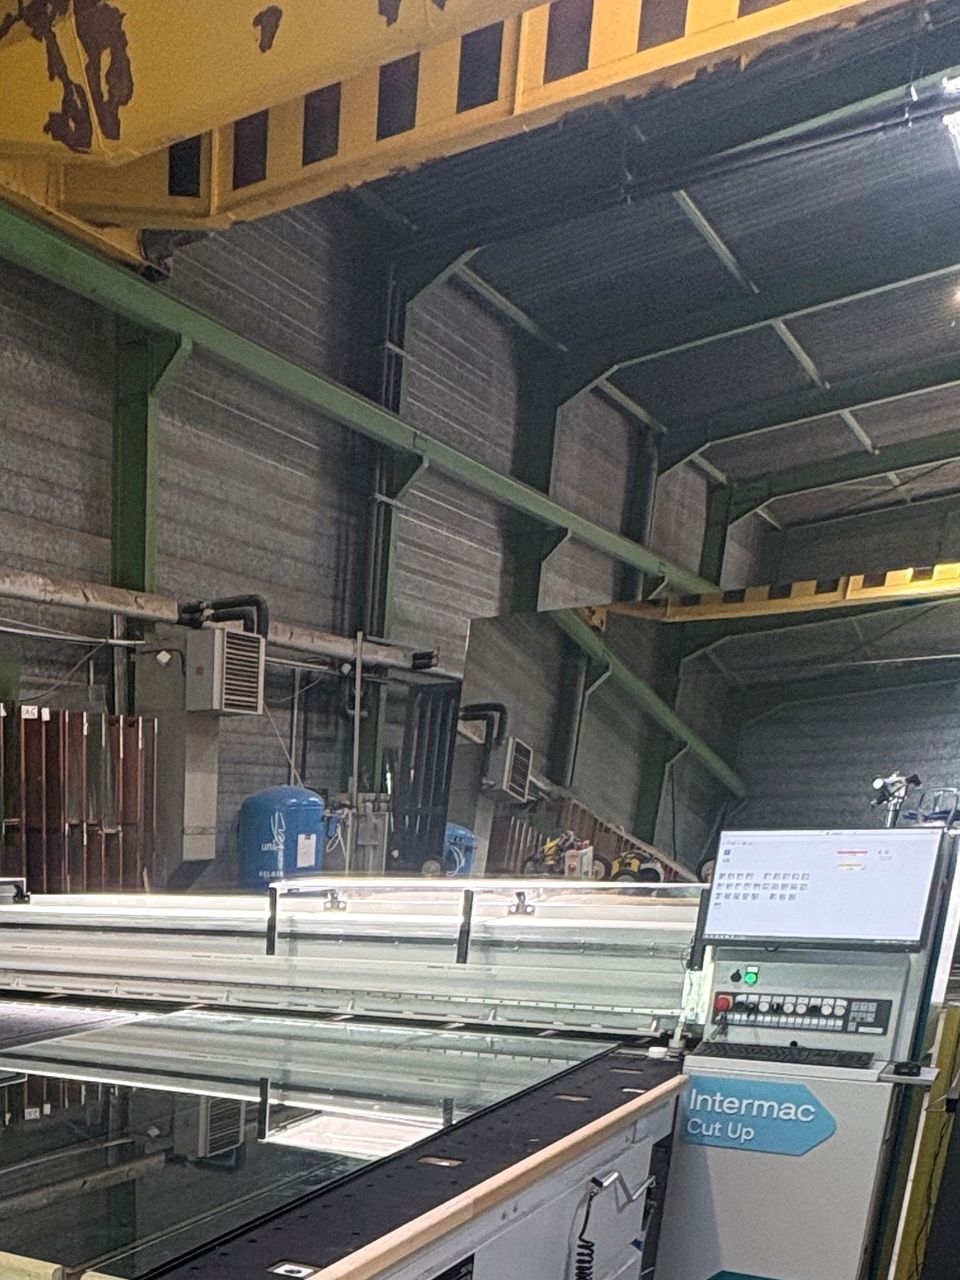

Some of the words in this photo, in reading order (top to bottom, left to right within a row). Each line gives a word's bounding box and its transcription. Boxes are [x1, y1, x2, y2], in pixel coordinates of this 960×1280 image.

[690, 1088, 816, 1122] Intermac
[687, 1118, 722, 1137] Cut
[727, 1122, 755, 1143] Up
